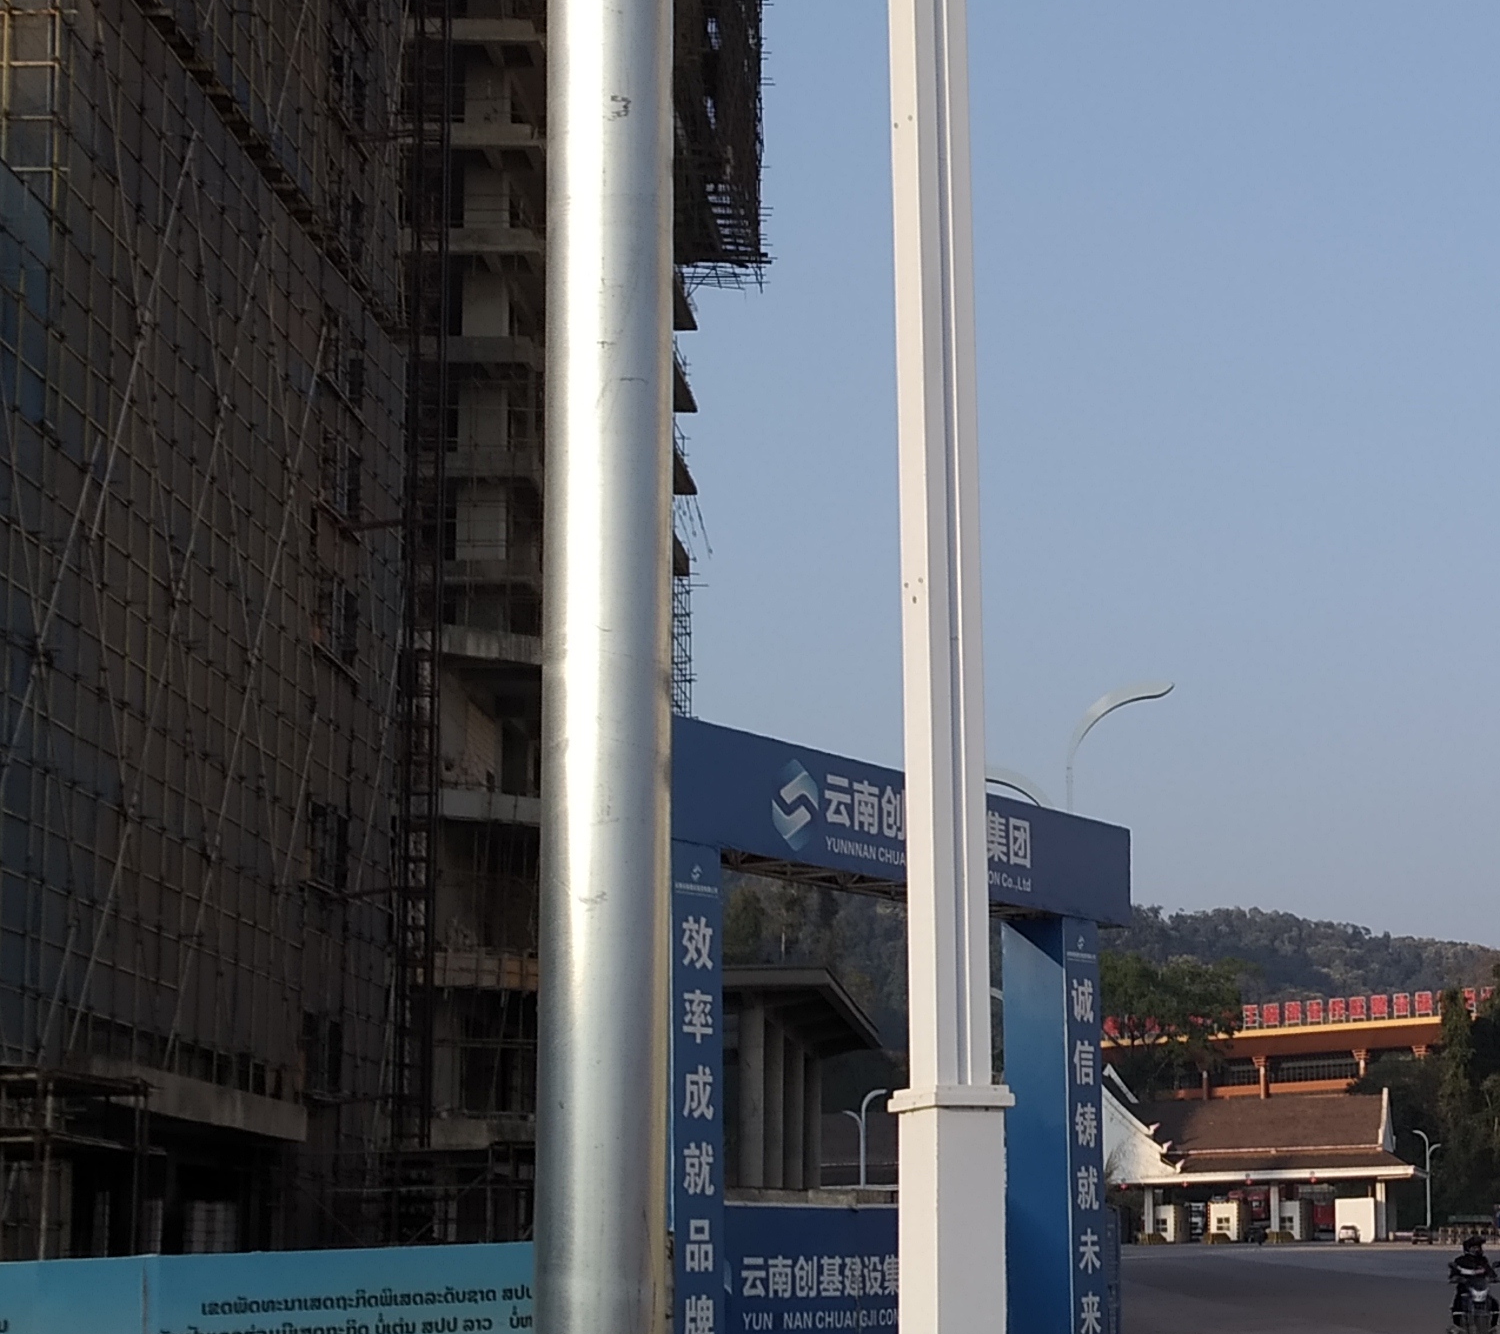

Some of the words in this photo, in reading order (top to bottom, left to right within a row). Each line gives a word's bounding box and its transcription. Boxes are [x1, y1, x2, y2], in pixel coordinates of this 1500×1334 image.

[825, 835, 877, 864] YUNNNAN
[877, 847, 907, 866] CHUA
[740, 1255, 899, 1299] 云南创基建设集
[743, 1312, 773, 1330] YUN
[783, 1312, 812, 1329] NAN
